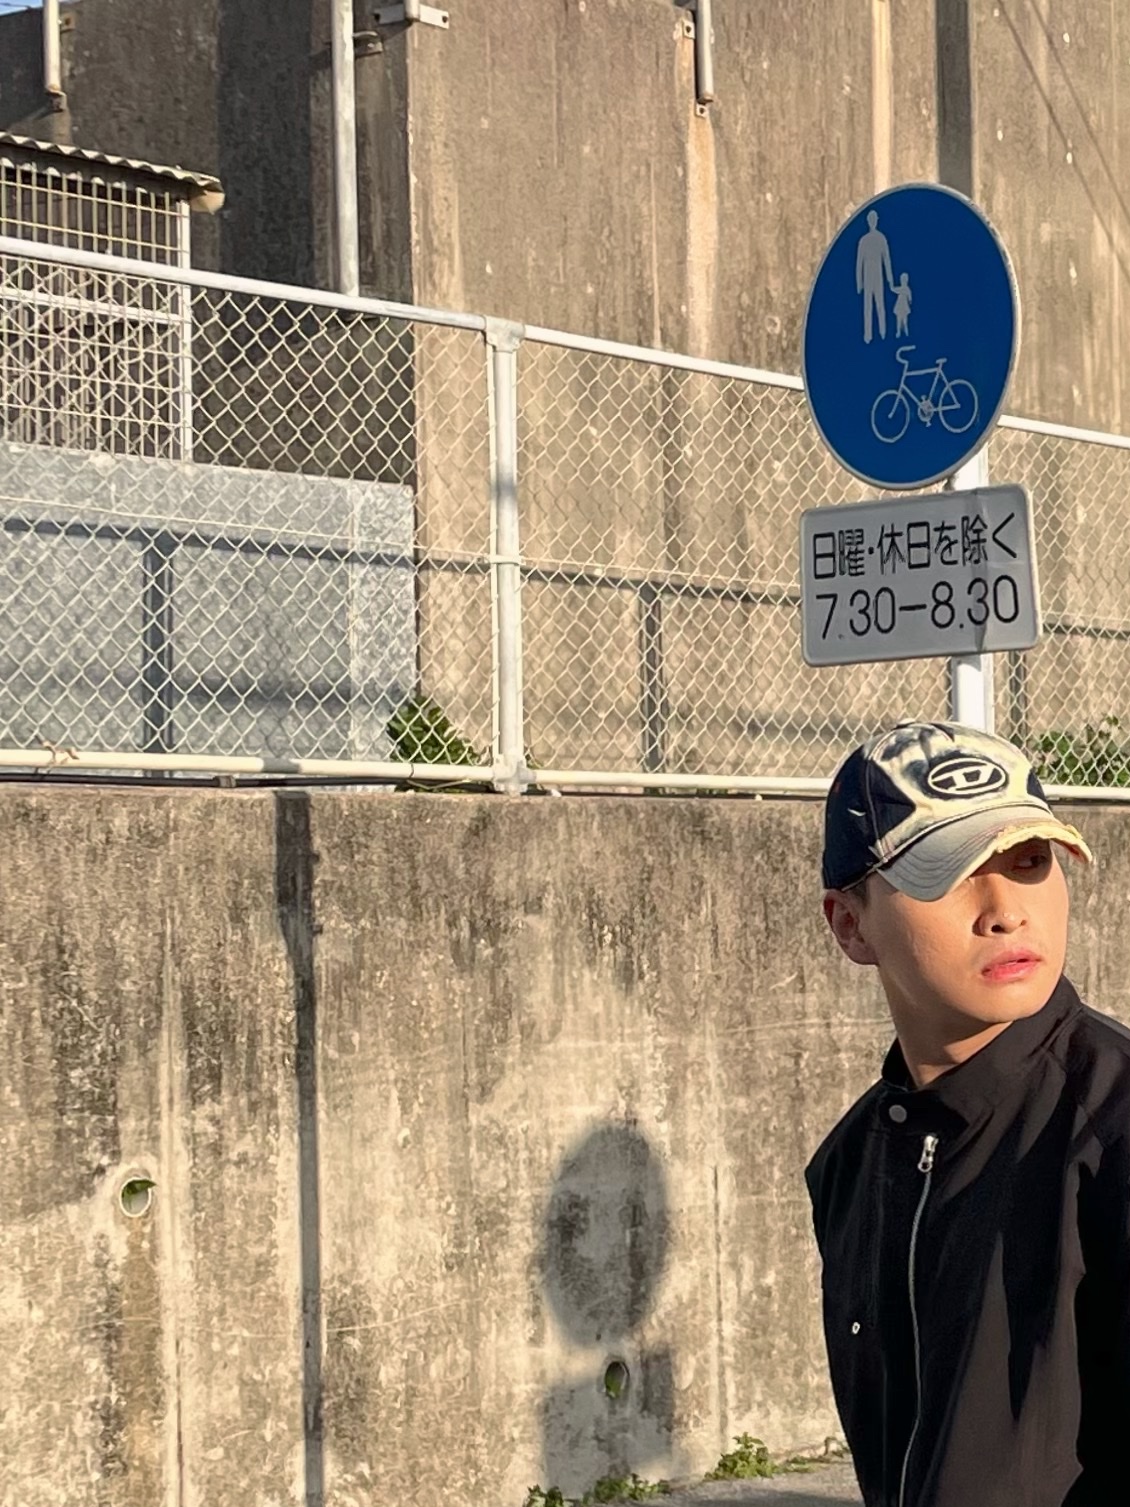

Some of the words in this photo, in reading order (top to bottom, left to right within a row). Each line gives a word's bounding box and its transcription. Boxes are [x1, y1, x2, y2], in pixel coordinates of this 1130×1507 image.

[813, 512, 1018, 580] 日曜・休日を除く
